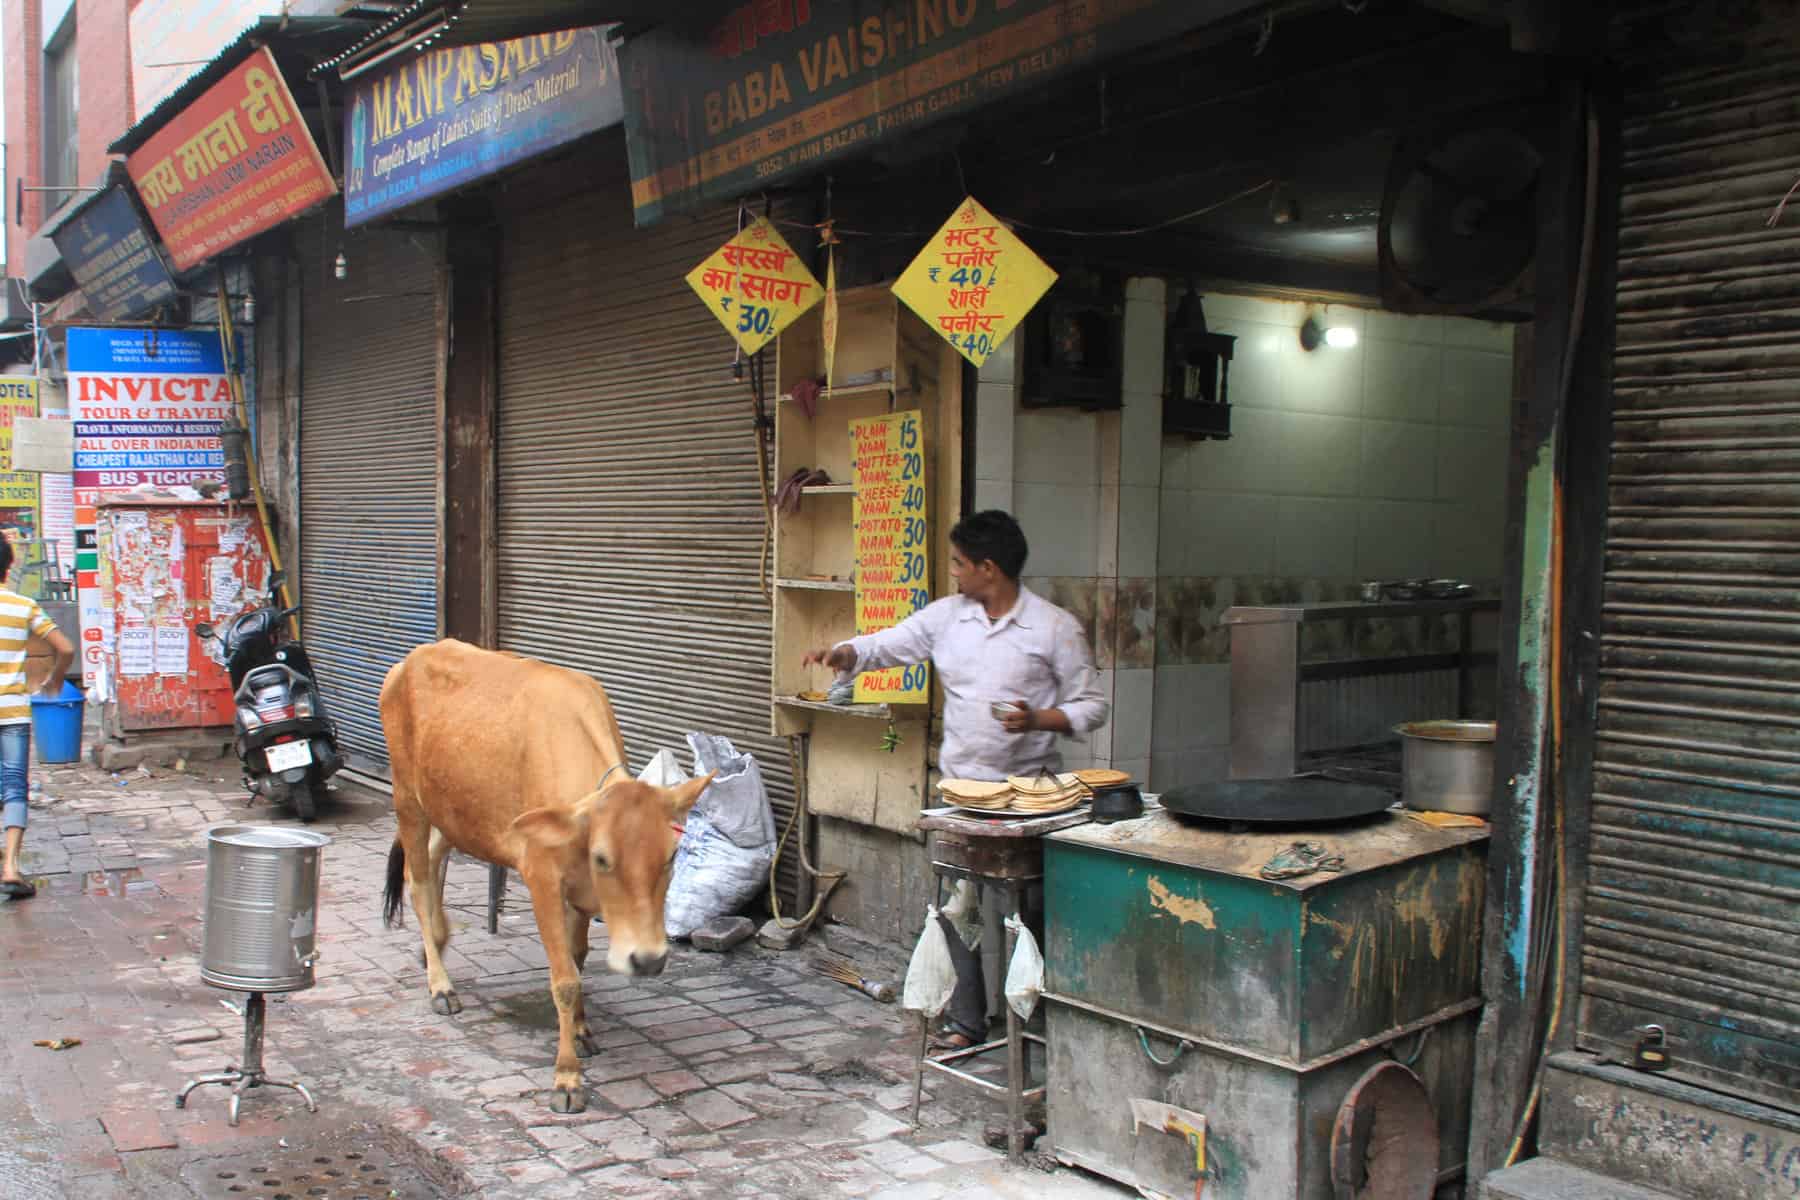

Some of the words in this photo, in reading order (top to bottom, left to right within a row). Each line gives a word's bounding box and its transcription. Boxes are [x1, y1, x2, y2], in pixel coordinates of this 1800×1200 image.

[703, 62, 793, 138] BABA
[799, 0, 978, 93] VAISHNO
[373, 142, 406, 180] Complete
[407, 136, 431, 165] Range
[432, 122, 443, 160] of
[442, 117, 469, 147] Ladies
[505, 86, 531, 119] Dress
[531, 54, 583, 106] Material
[137, 157, 184, 210] जय
[175, 107, 250, 182] माता
[240, 67, 293, 136] दी
[246, 134, 297, 177] NARAIN
[944, 226, 1001, 248] मटर
[941, 246, 1004, 269] पनीर
[702, 267, 738, 293] का
[739, 272, 812, 307] साग
[948, 286, 991, 311] शाही
[937, 310, 1006, 334] पनीर
[78, 376, 232, 402] INVICTA
[80, 407, 131, 419] TOUR
[136, 407, 151, 419] &
[154, 407, 233, 419] TRAVELS
[76, 424, 111, 434] TRAVEL
[112, 424, 174, 434] INFORMATION
[175, 424, 184, 434] &
[900, 419, 918, 450] 15
[80, 439, 107, 450] ALL
[111, 439, 150, 450] OVER
[858, 440, 887, 455] NAAN
[76, 453, 127, 466] CHEAPEST
[128, 453, 186, 466] RAJASTHAN
[187, 453, 206, 466] CAR
[902, 452, 921, 480] 20
[98, 472, 139, 485] BUS
[143, 471, 225, 485] TICKETS
[861, 501, 890, 515] NAAN
[902, 484, 924, 512] 40
[860, 535, 894, 551] NAAN
[903, 517, 925, 548] 30
[863, 569, 893, 584] NAAN
[900, 551, 925, 583] 30
[863, 605, 896, 621] NAAN
[159, 631, 184, 640] BODY
[863, 676, 902, 692] PULAO
[902, 662, 926, 691] 60
